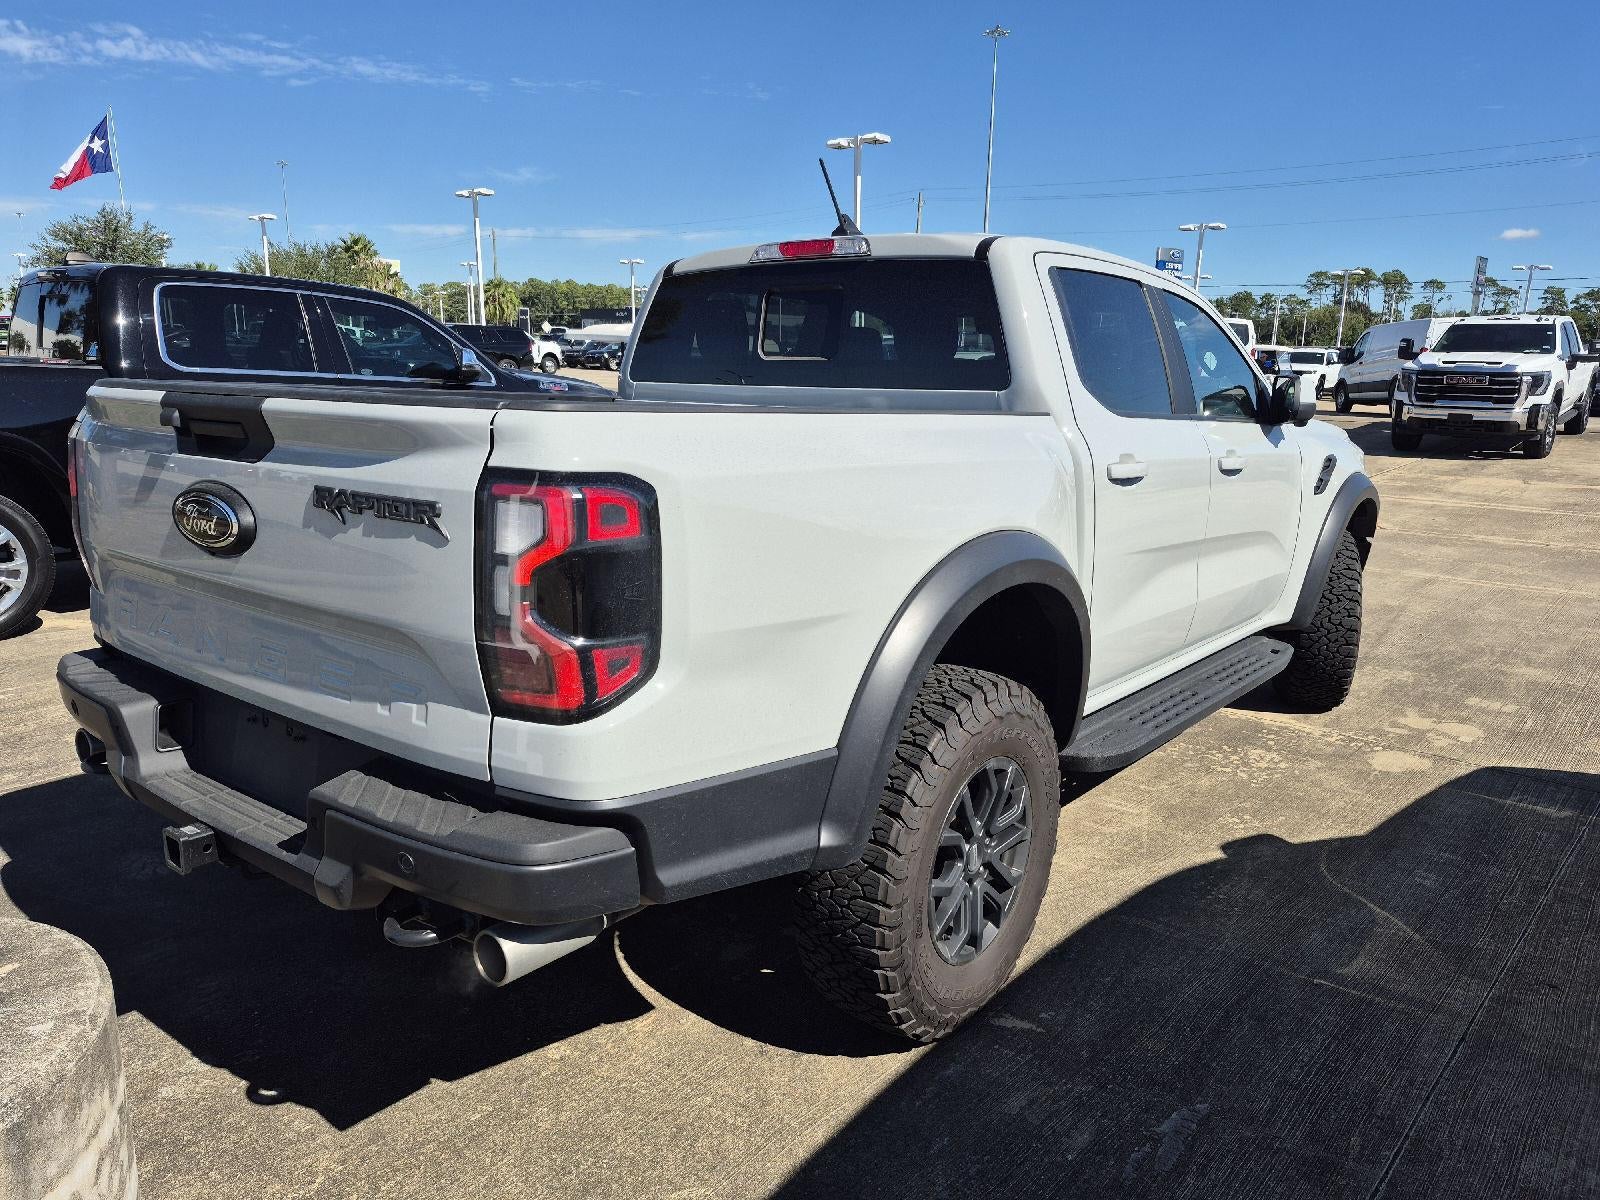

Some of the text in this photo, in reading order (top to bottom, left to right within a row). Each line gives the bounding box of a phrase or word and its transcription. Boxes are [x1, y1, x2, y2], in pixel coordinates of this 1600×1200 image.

[1446, 375, 1487, 385] GMC
[183, 503, 218, 536] Ford
[313, 485, 450, 540] RAPTOR
[119, 597, 428, 728] RANGER
